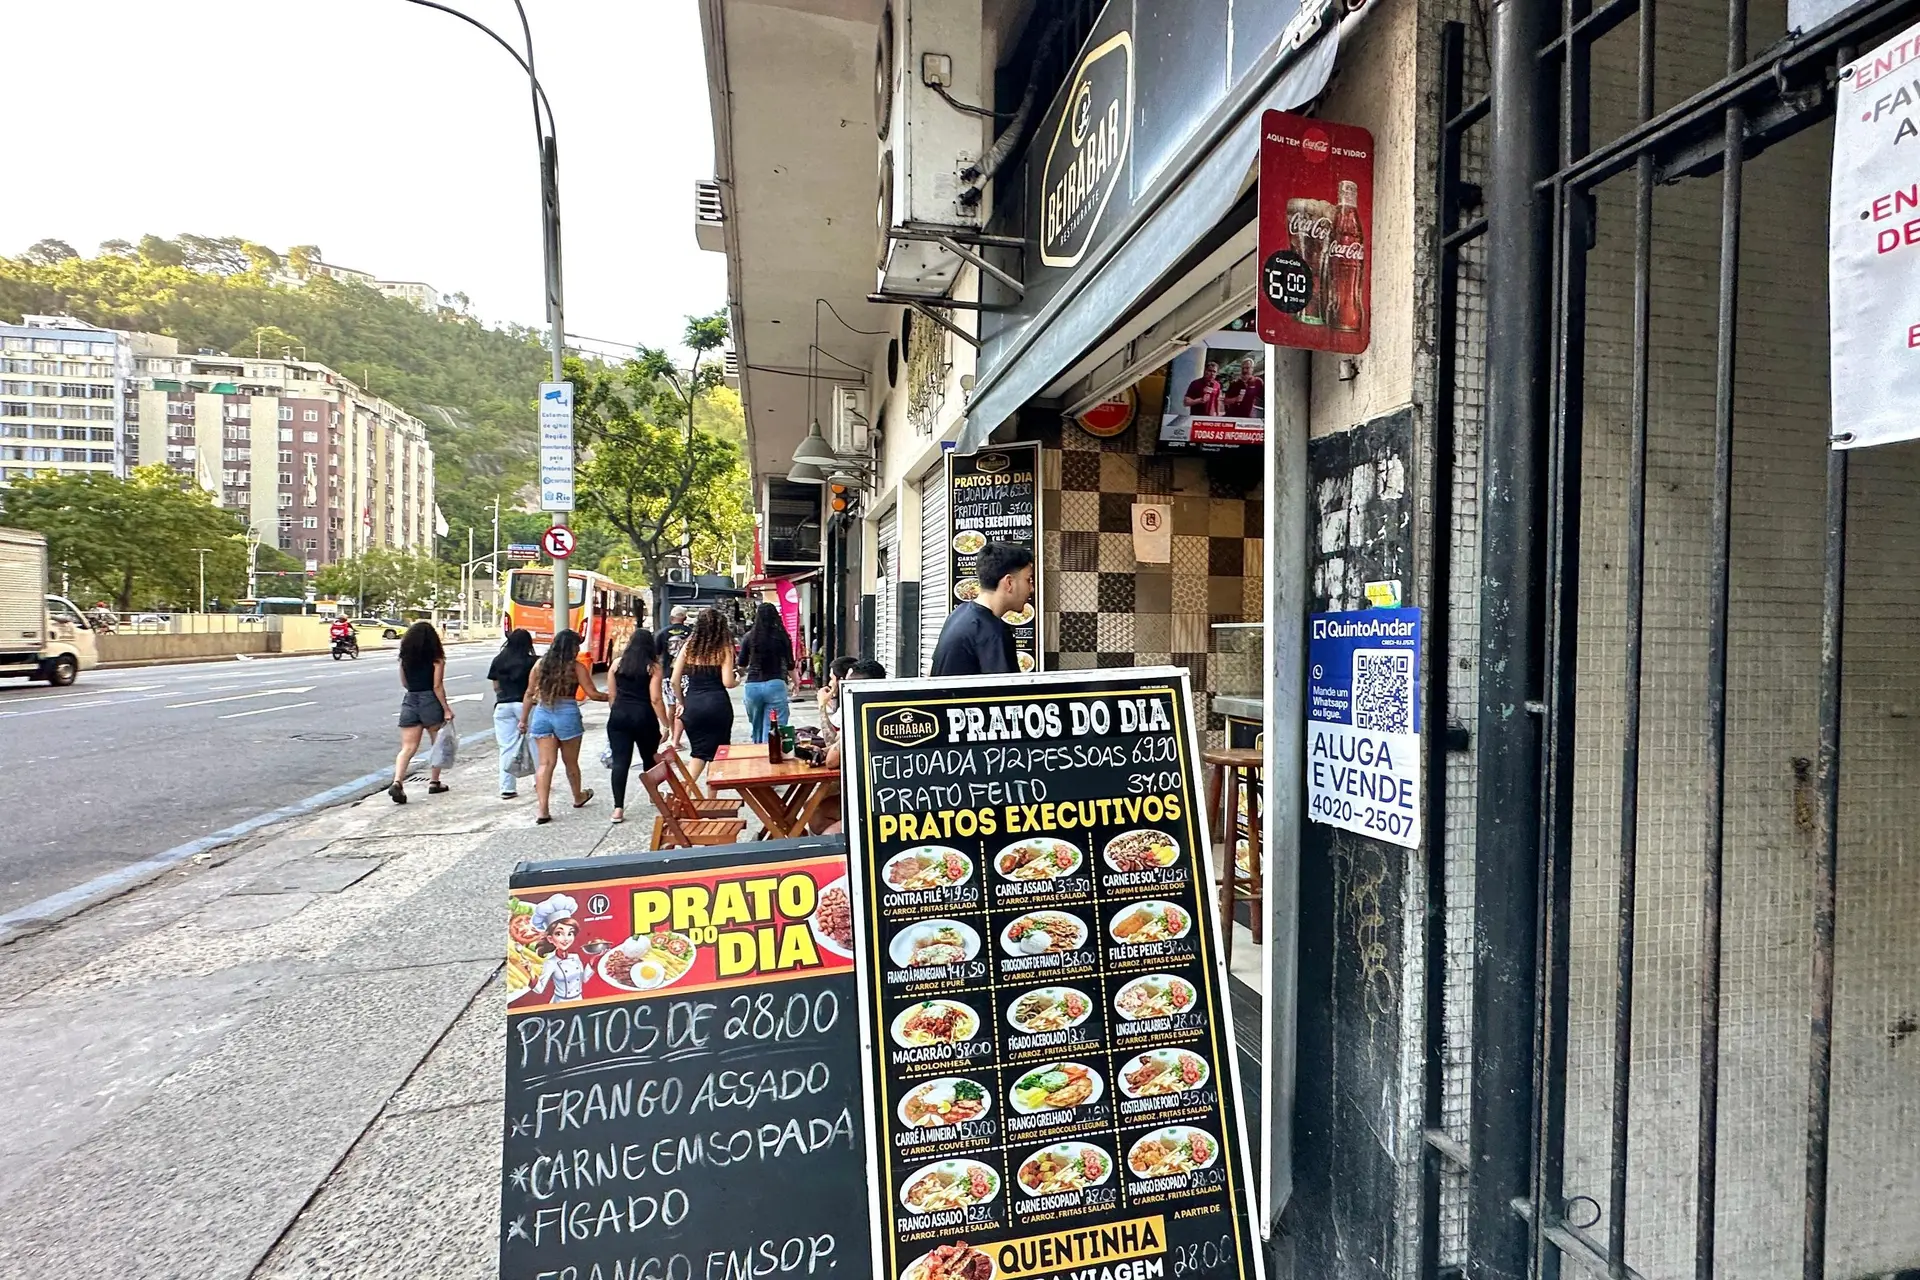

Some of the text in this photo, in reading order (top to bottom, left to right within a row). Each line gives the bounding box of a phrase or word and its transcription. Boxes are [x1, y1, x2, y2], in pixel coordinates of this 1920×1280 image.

[1267, 133, 1284, 143] AQUI
[1332, 147, 1341, 155] DE
[1343, 149, 1366, 158] VIDRO
[1048, 98, 1118, 246] BEIRABAR
[1060, 189, 1100, 246] RESTAURANTE
[954, 472, 1033, 488] PRATOS DO DIA
[556, 492, 570, 500] Rio
[956, 514, 1032, 530] PRATOS EXECUTIVOS
[1328, 619, 1415, 637] QuintoAndar
[1313, 686, 1335, 696] Mande
[1313, 696, 1348, 710] Whatsapp
[883, 722, 932, 736] BEIRABAR
[946, 698, 1171, 743] PRATOS DO DIA
[1313, 732, 1393, 770] ALUGA
[872, 750, 977, 784] FEIJOADA
[1314, 761, 1413, 809] E VENDE
[876, 786, 962, 812] PRATO
[969, 778, 1047, 808] FEITO
[879, 794, 1182, 842] PRATOS EXECUTIVOS
[1312, 793, 1414, 838] 4020-2507
[996, 881, 1053, 896] CARNE ASSADA
[1103, 873, 1129, 887] CARNE
[1130, 872, 1140, 884] DE
[1141, 871, 1156, 883] SOL
[1140, 883, 1159, 892] BAIÃO
[633, 874, 816, 934] PRATO
[884, 887, 942, 906] CONTRA FILÉ
[921, 902, 977, 912] FRITAS SALADA
[690, 924, 718, 946] DO
[719, 925, 819, 978] DIA
[1109, 944, 1126, 960] FILÉ
[1127, 945, 1139, 958] DE
[1140, 942, 1163, 956] PEIXE
[1001, 954, 1059, 972] STROGONOFF DE FRANGO
[1038, 965, 1093, 977] FRITAS SALADA
[887, 966, 947, 984] FRANGO PARMEGIANA
[946, 978, 965, 987] PURÊ
[516, 1005, 661, 1068] PRATOS
[667, 1001, 718, 1048] DE
[1116, 1017, 1171, 1036] LINGUIÇA CALABRESA
[1178, 1029, 1204, 1037] SALADA
[1008, 1031, 1066, 1050] FÍGADO ACEBOLADO
[1045, 1042, 1099, 1055] FRITAS SALADA
[892, 1044, 952, 1064] MACARRÃO
[906, 1059, 971, 1072] À BOLONHESA
[535, 1062, 831, 1139] FRANGO ASSADO
[1120, 1098, 1153, 1114] COSTELINHA
[1153, 1097, 1160, 1109] DE
[1161, 1094, 1180, 1108] PORCO
[1008, 1117, 1035, 1131] FRANGO
[1037, 1110, 1073, 1127] GRELHADO
[1048, 1126, 1077, 1135] BRÓCOLIS
[1082, 1120, 1108, 1130] LEGUMES
[895, 1125, 957, 1147] CARRÉ À MINEIRA
[940, 1138, 990, 1150] COUVE TUTU
[530, 1144, 647, 1199] CARNE
[1129, 1176, 1187, 1196] FRANGO ENSOPADO
[1015, 1192, 1080, 1214] CARNE ENSOPADA
[1174, 1204, 1221, 1220] A PARTIR DE
[534, 1188, 689, 1247] FIGADO
[898, 1211, 962, 1233] FRANGO ASSADO
[998, 1220, 1160, 1274] QUENTINHA
